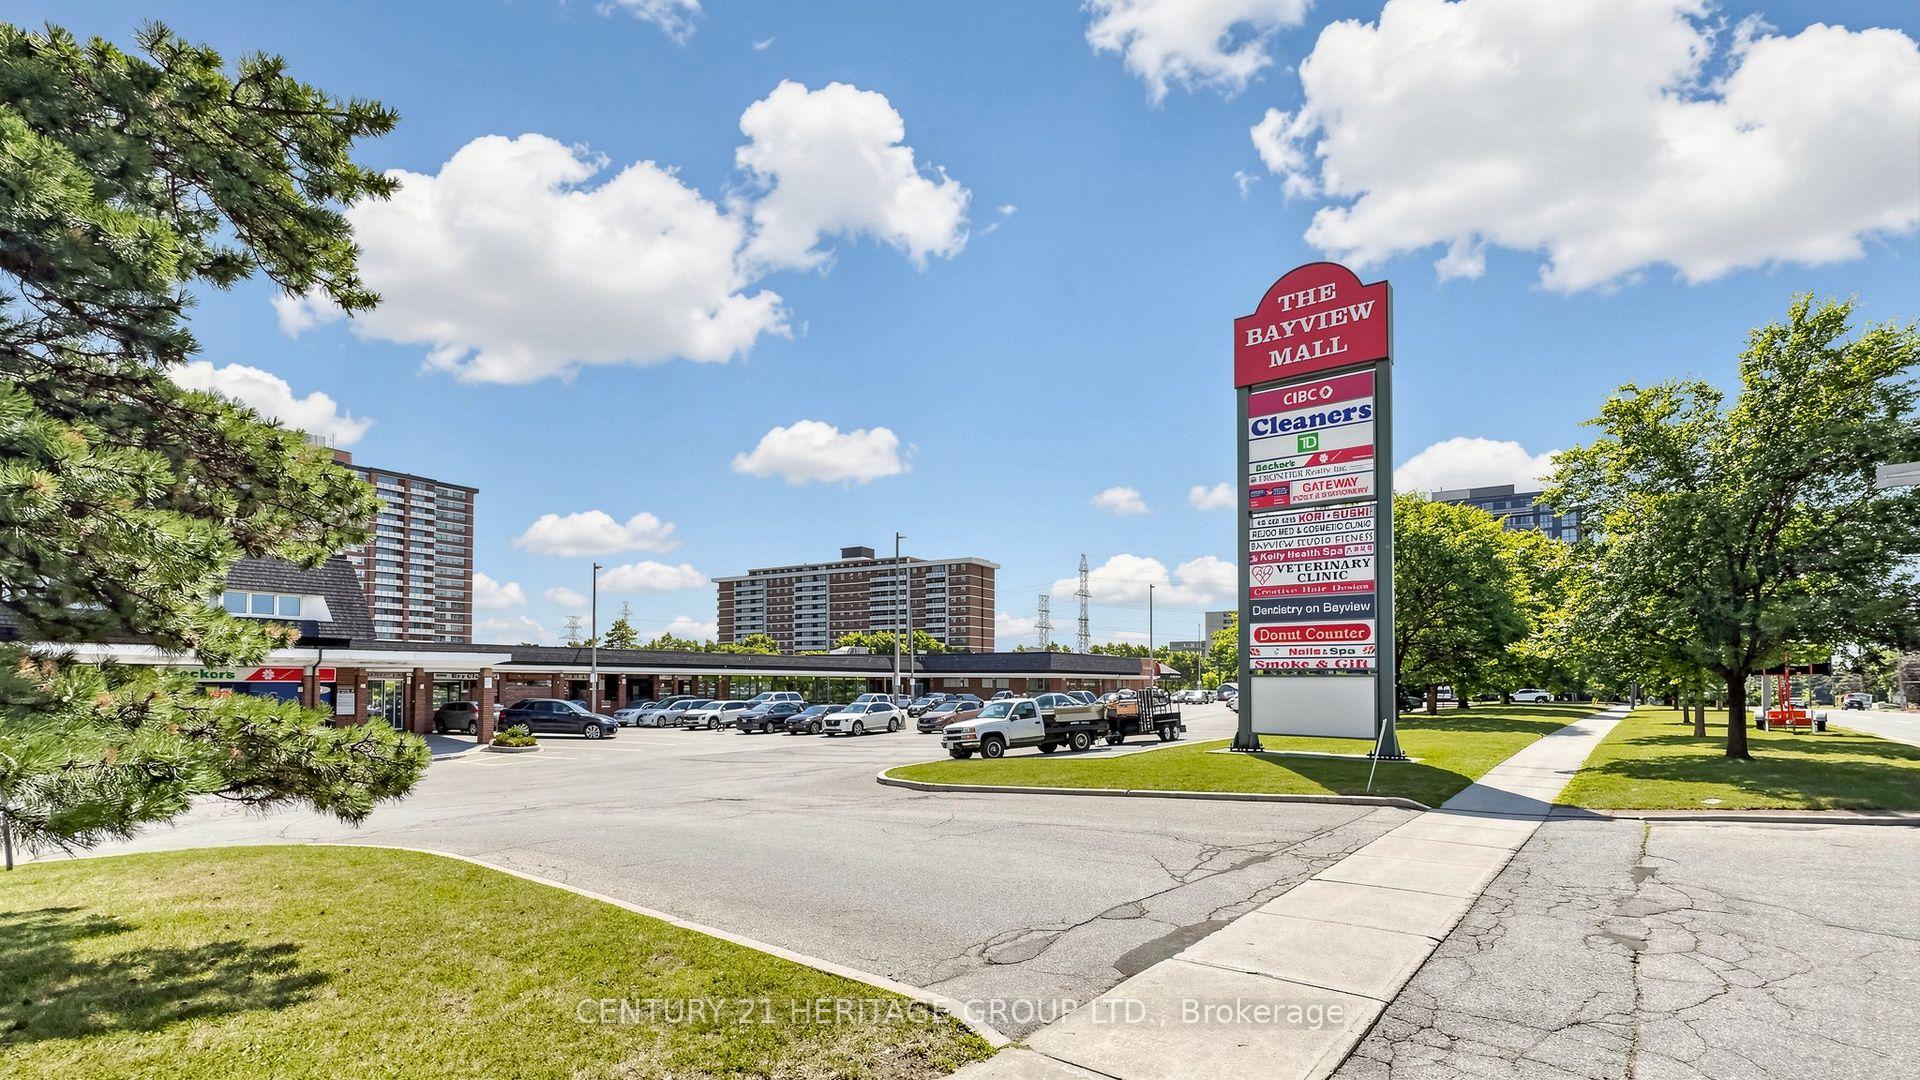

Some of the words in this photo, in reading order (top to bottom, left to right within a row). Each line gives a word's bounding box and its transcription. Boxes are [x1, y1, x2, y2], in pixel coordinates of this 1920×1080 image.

[1277, 282, 1336, 312] THE
[1245, 300, 1375, 347] BAYVIEW
[1268, 336, 1348, 368] MALL
[1283, 388, 1317, 405] CIBC
[1251, 404, 1372, 436] Cleaners
[1299, 436, 1317, 449] TD
[1259, 470, 1303, 482] FRONTIER
[1305, 467, 1331, 477] Realty
[1302, 477, 1359, 492] GATEWAY
[1298, 511, 1325, 523] KORI
[1332, 507, 1369, 519] SUSHI
[1278, 527, 1294, 536] MED
[1303, 522, 1343, 533] COSMETIC
[1344, 520, 1371, 530] CLINIC
[1250, 539, 1294, 551] BAYVIEW
[1297, 536, 1331, 547] STUDIO
[1287, 549, 1321, 559] Health
[1322, 547, 1343, 557] Spa
[1276, 558, 1371, 574] VETERINARY
[1297, 570, 1348, 583] CLINIC
[1253, 588, 1298, 596] Creative
[1252, 604, 1303, 615] Dentistry
[1305, 605, 1320, 613] on
[1323, 601, 1371, 614] Bayview
[1260, 629, 1302, 641] Donut
[1305, 627, 1366, 640] Counter
[1329, 647, 1356, 656] Spa
[1255, 659, 1310, 669] Smoke
[1316, 659, 1328, 669] &
[1335, 659, 1369, 669] Gift
[174, 668, 235, 679] eckers
